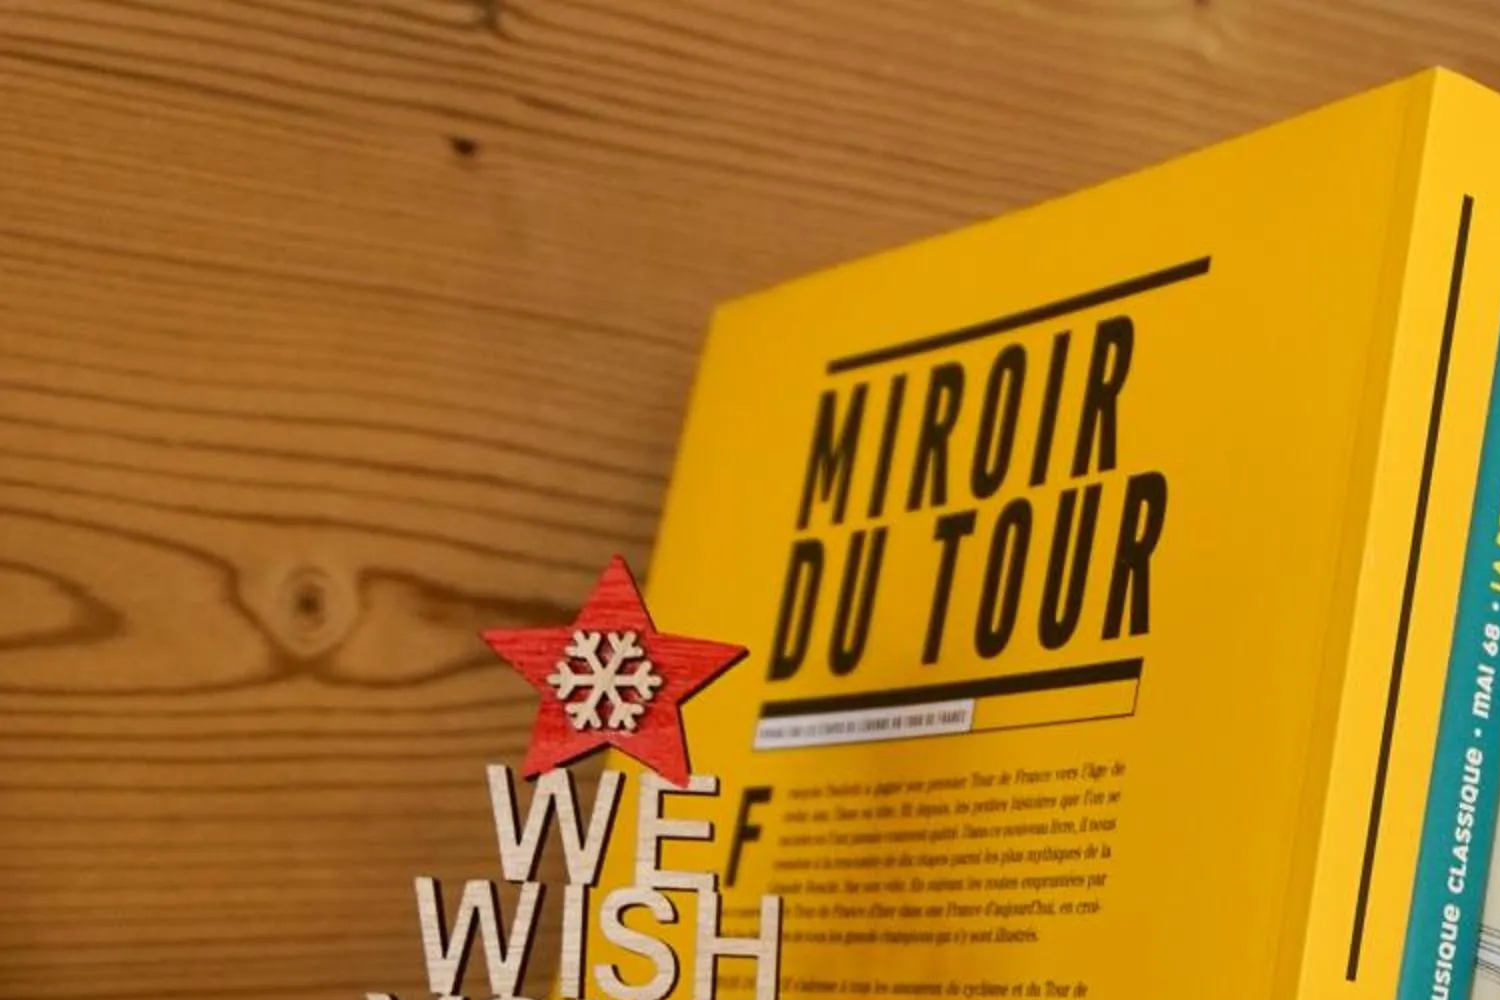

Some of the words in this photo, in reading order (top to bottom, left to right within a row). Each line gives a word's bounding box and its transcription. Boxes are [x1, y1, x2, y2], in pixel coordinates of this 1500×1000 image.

[795, 314, 1135, 531] MIROIR
[765, 525, 890, 682] DU
[922, 470, 1169, 666] TOUR
[1471, 665, 1497, 719] MAI
[487, 764, 718, 892] WE
